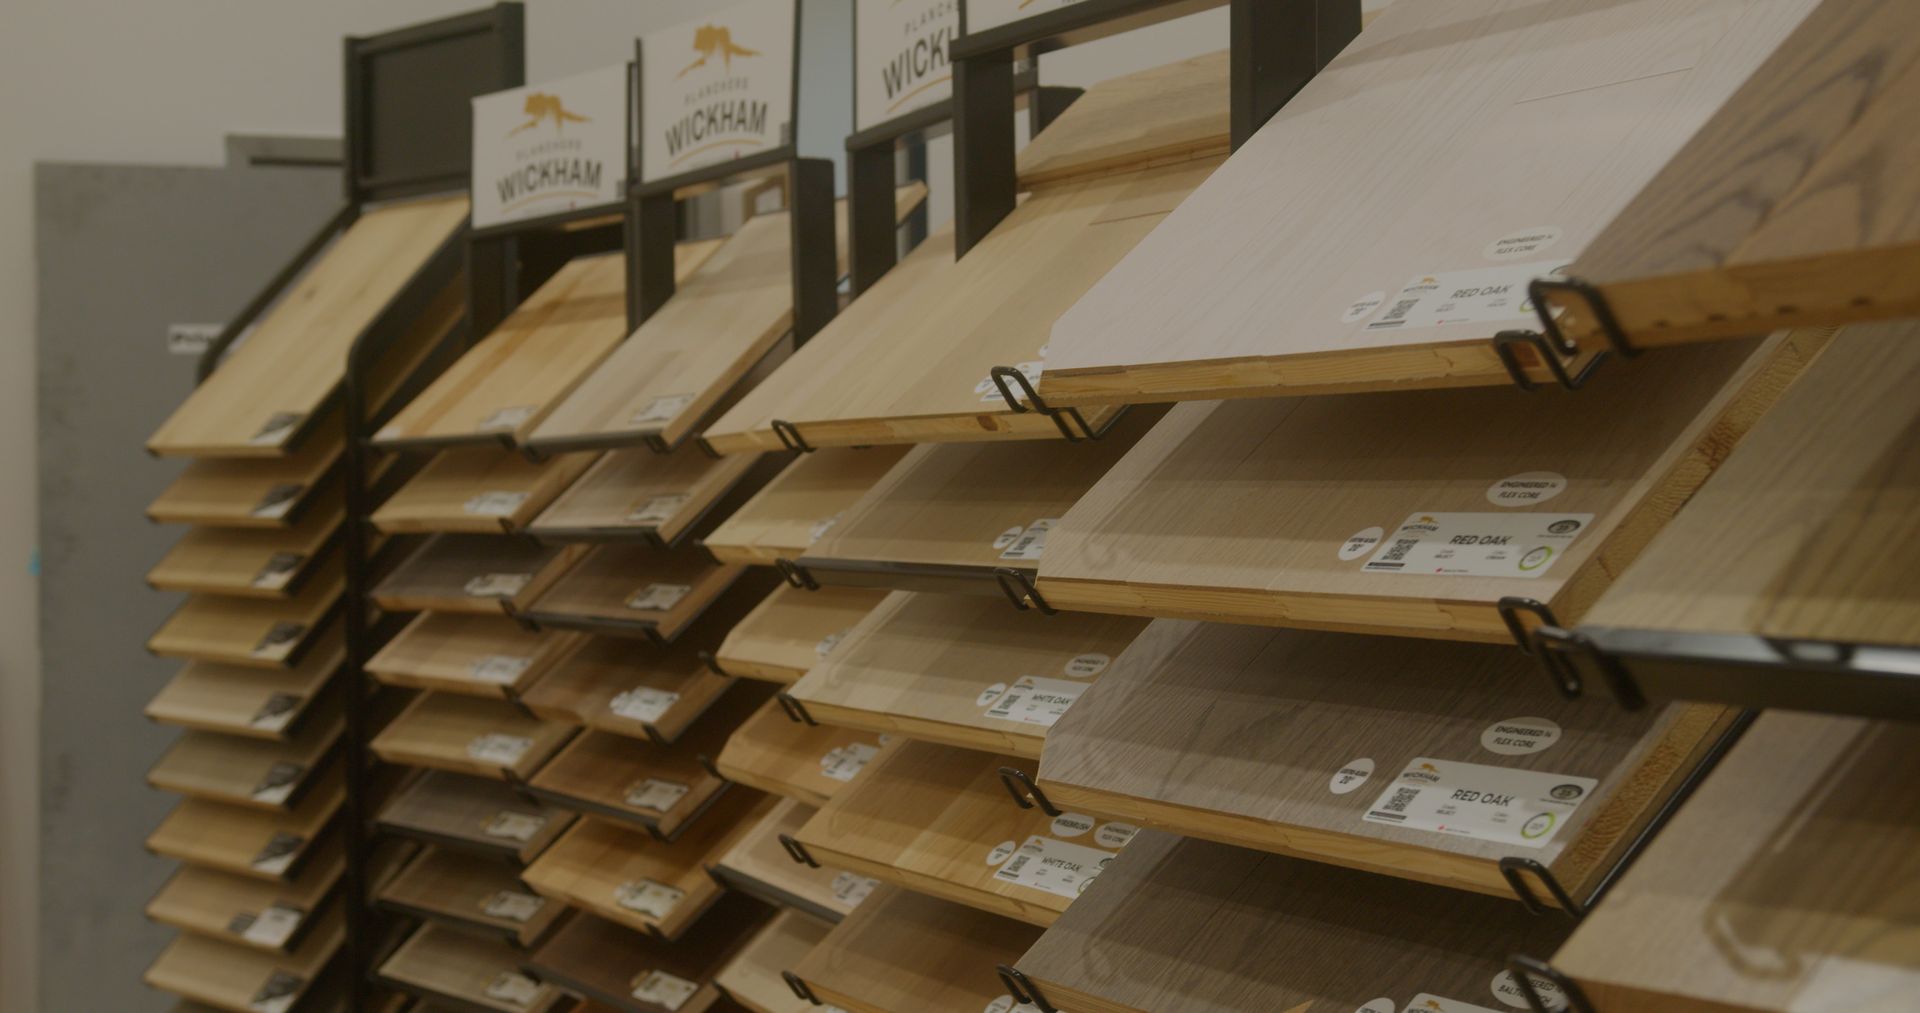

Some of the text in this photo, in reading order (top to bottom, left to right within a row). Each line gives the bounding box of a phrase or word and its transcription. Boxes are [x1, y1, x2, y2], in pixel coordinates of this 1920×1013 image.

[665, 99, 767, 156] WICKHAM
[496, 157, 602, 203] WICKHAM
[1451, 284, 1514, 299] RED OAK
[1518, 491, 1541, 499] CORE
[1401, 524, 1439, 532] WICKHAM
[1449, 535, 1513, 545] RED OAK
[1032, 694, 1074, 705] WHITE OAK
[1494, 725, 1544, 737] ENGINEERED
[1493, 737, 1537, 748] FLEX CORE
[1403, 772, 1440, 783] WICKHAM
[1450, 789, 1516, 807] RED OAK
[1055, 817, 1091, 830] WIREBRUSH
[1042, 856, 1083, 872] WHITE OAK
